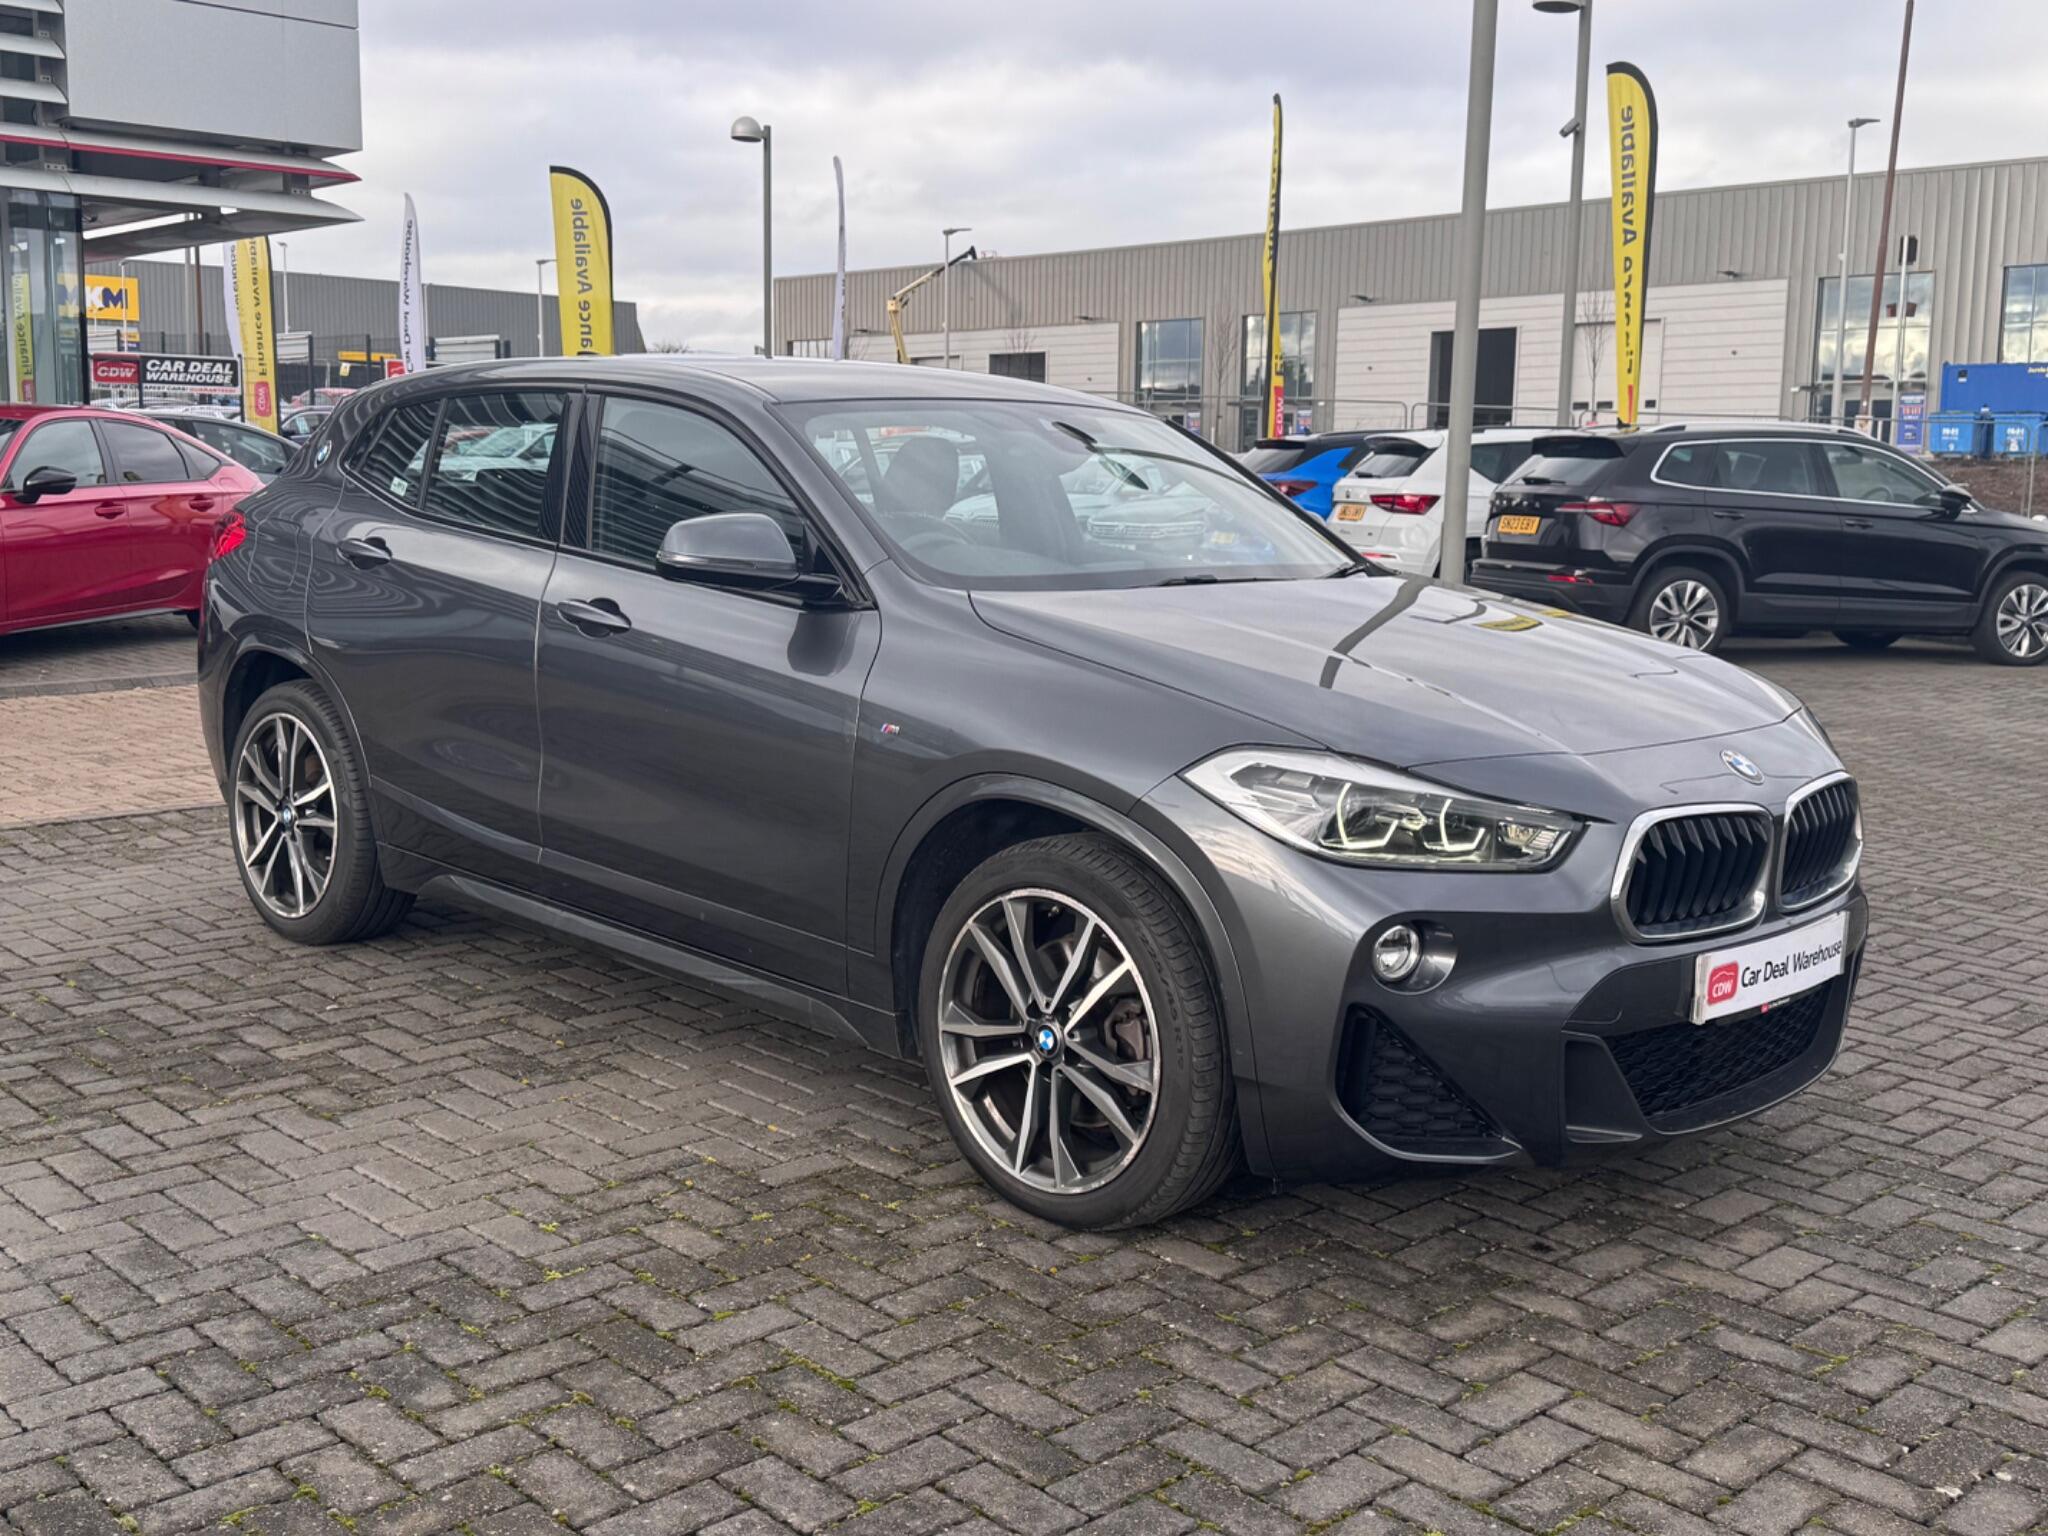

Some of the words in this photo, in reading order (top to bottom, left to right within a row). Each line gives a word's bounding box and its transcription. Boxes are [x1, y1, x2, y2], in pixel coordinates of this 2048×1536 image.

[97, 366, 135, 378] CDW
[146, 359, 185, 372] CAR
[188, 361, 233, 374] DEAL
[146, 372, 232, 384] WAREHOUSE
[1741, 966, 1762, 988] Car
[1763, 955, 1790, 983] Deal
[1793, 940, 1842, 972] Warehouse
[1711, 979, 1734, 998] CDW
